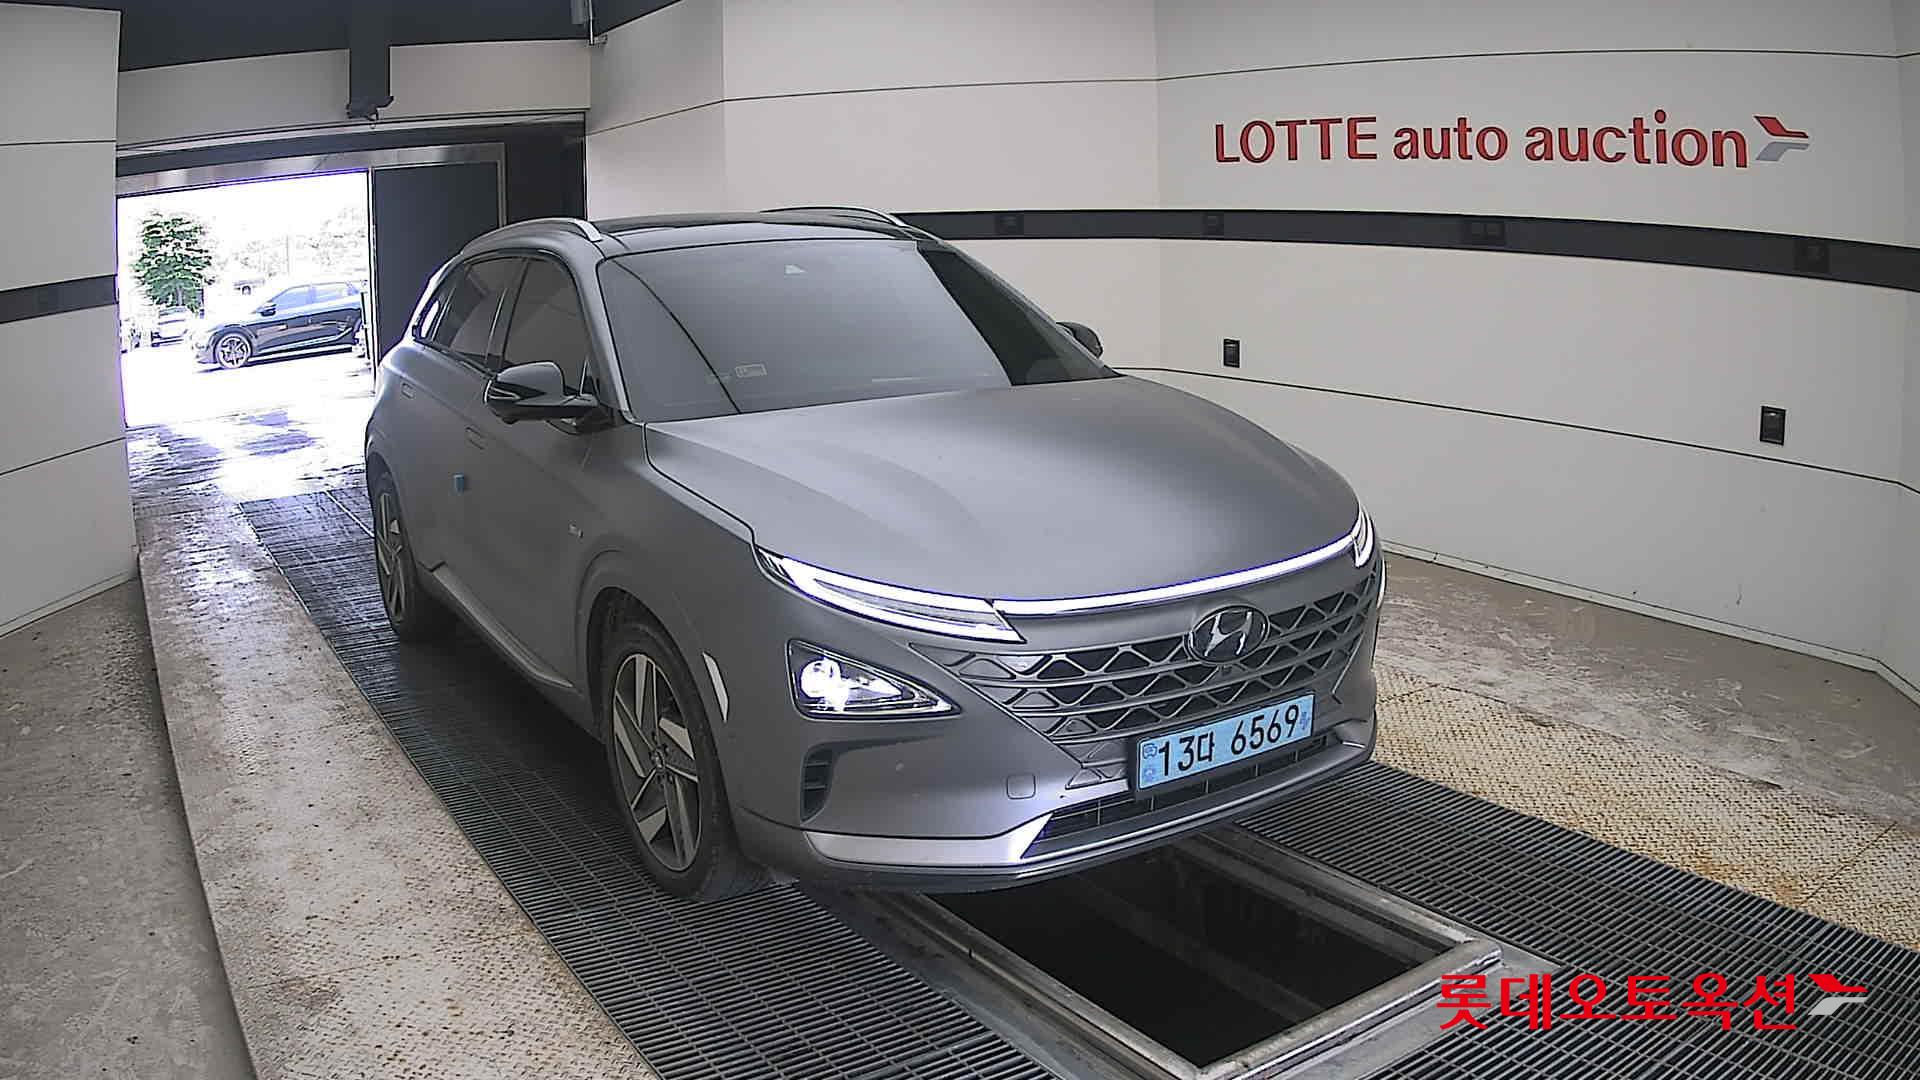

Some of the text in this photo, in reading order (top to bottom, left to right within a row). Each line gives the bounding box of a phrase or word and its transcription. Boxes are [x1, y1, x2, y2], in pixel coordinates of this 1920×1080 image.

[1215, 109, 1748, 169] LOTTE auto auction
[1158, 704, 1300, 776] 13다 6569
